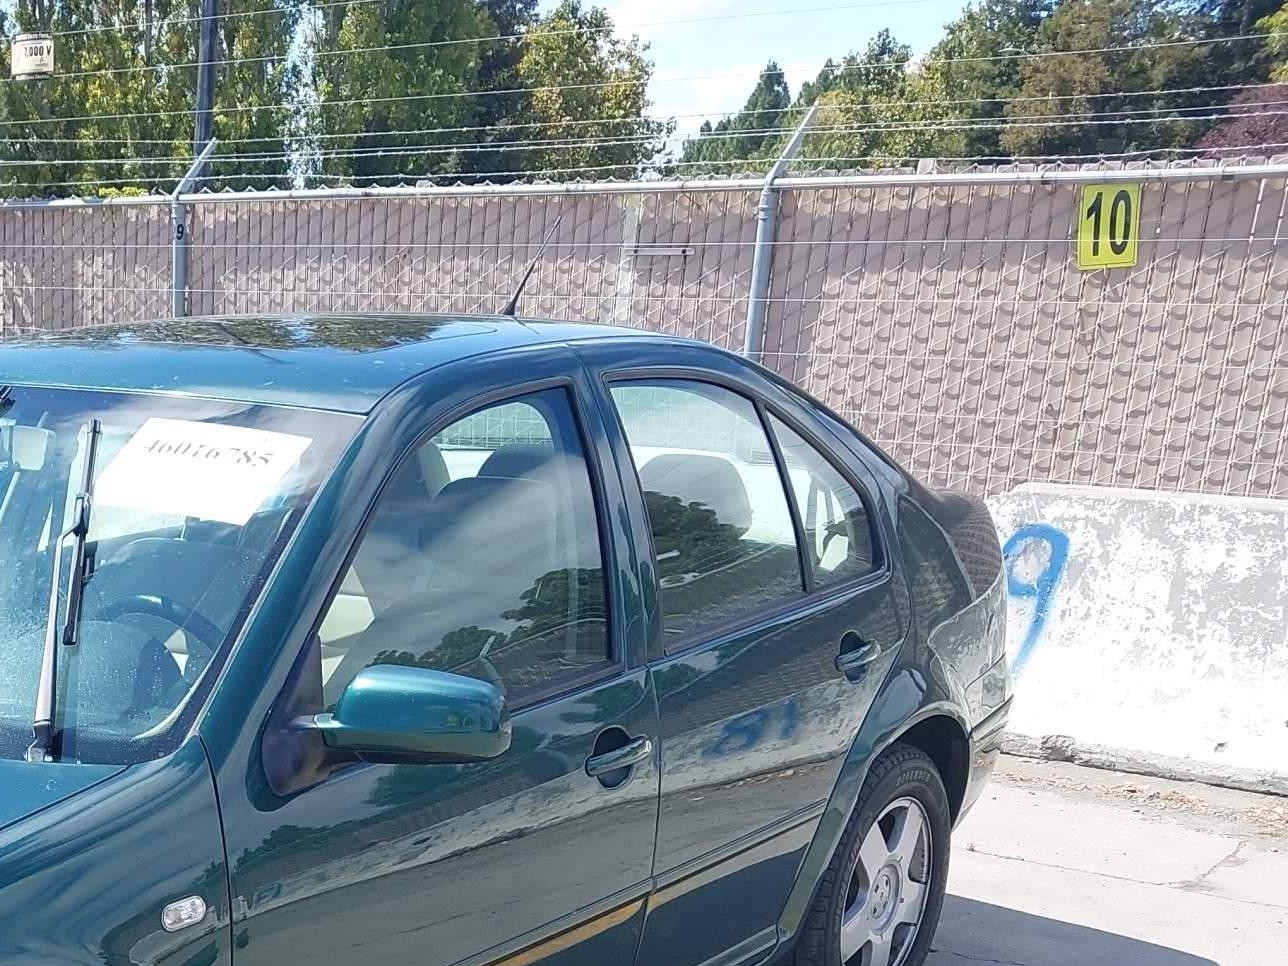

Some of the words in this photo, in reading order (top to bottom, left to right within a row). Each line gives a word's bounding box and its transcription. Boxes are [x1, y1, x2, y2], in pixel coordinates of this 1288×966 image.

[24, 45, 44, 59] 7,000
[46, 45, 52, 56] V
[176, 223, 185, 241] 9
[1086, 189, 1132, 257] 10
